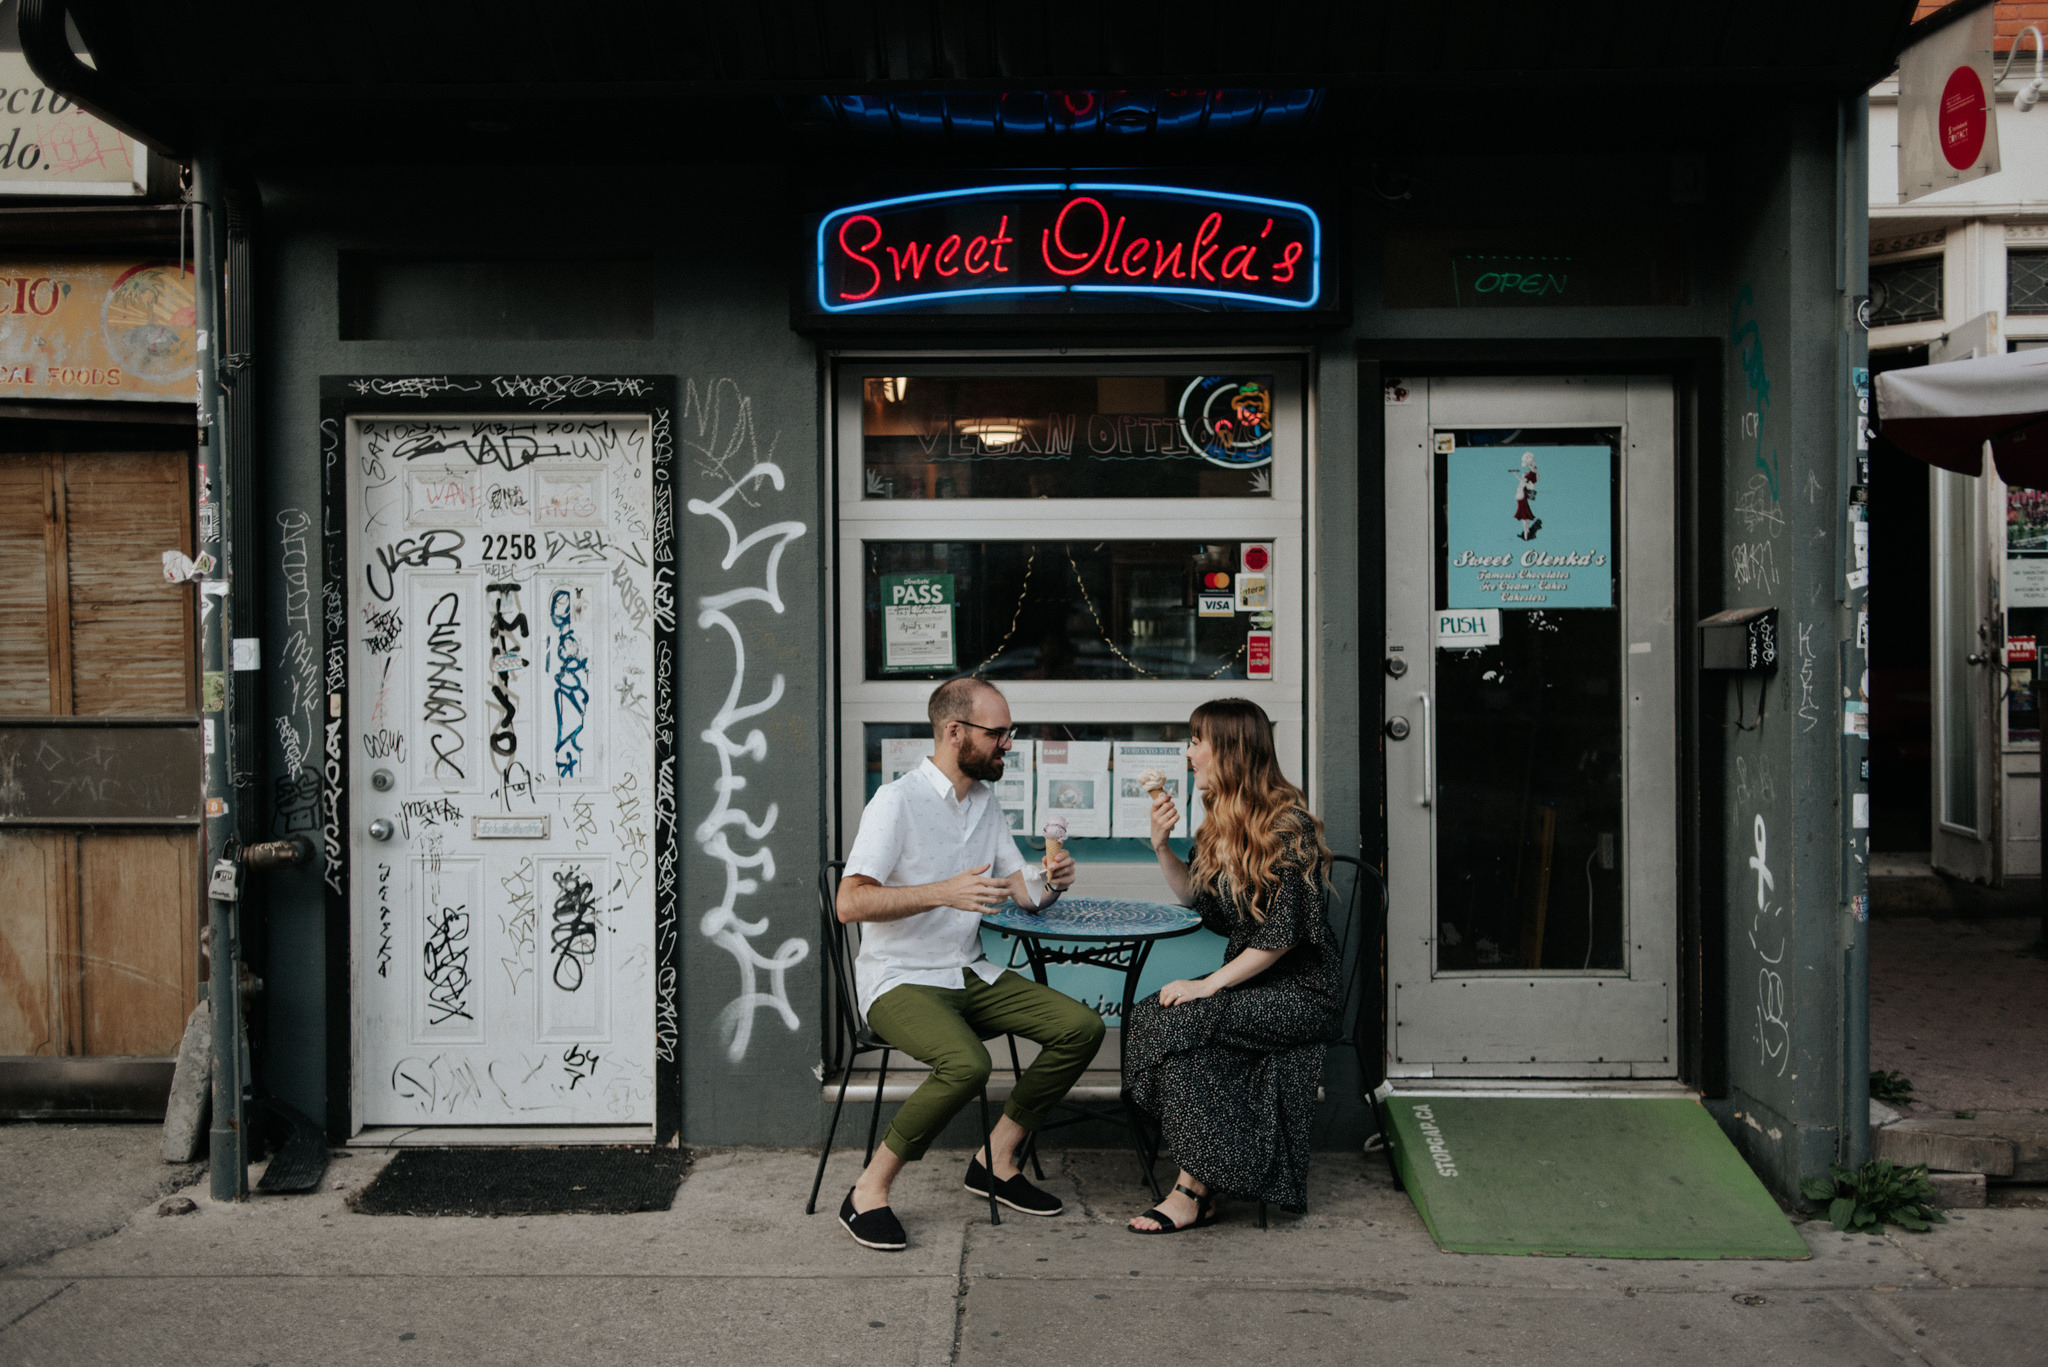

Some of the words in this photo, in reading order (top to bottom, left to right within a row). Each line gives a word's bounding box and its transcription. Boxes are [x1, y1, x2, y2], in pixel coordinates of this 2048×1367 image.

[0, 86, 84, 115] cio
[839, 214, 1013, 300] Sweet
[1042, 196, 1303, 284] Olenka's
[1474, 272, 1568, 296] OPEN
[48, 367, 121, 385] FOODS
[914, 412, 1077, 457] VEGAN
[481, 534, 537, 561] 225B
[1453, 550, 1513, 567] Sweet
[1520, 548, 1607, 568] Olenka's
[1476, 569, 1517, 580] Famous
[1518, 568, 1570, 580] Chocolates
[892, 584, 944, 605] PASS
[1479, 581, 1497, 591] Ice
[1498, 580, 1530, 591] Cream
[1537, 580, 1567, 591] Cakes
[1204, 601, 1230, 610] VISA
[1439, 616, 1486, 634] PUSH
[2007, 641, 2035, 651] ATM
[1412, 1104, 1459, 1178] STOPGAP.CA
